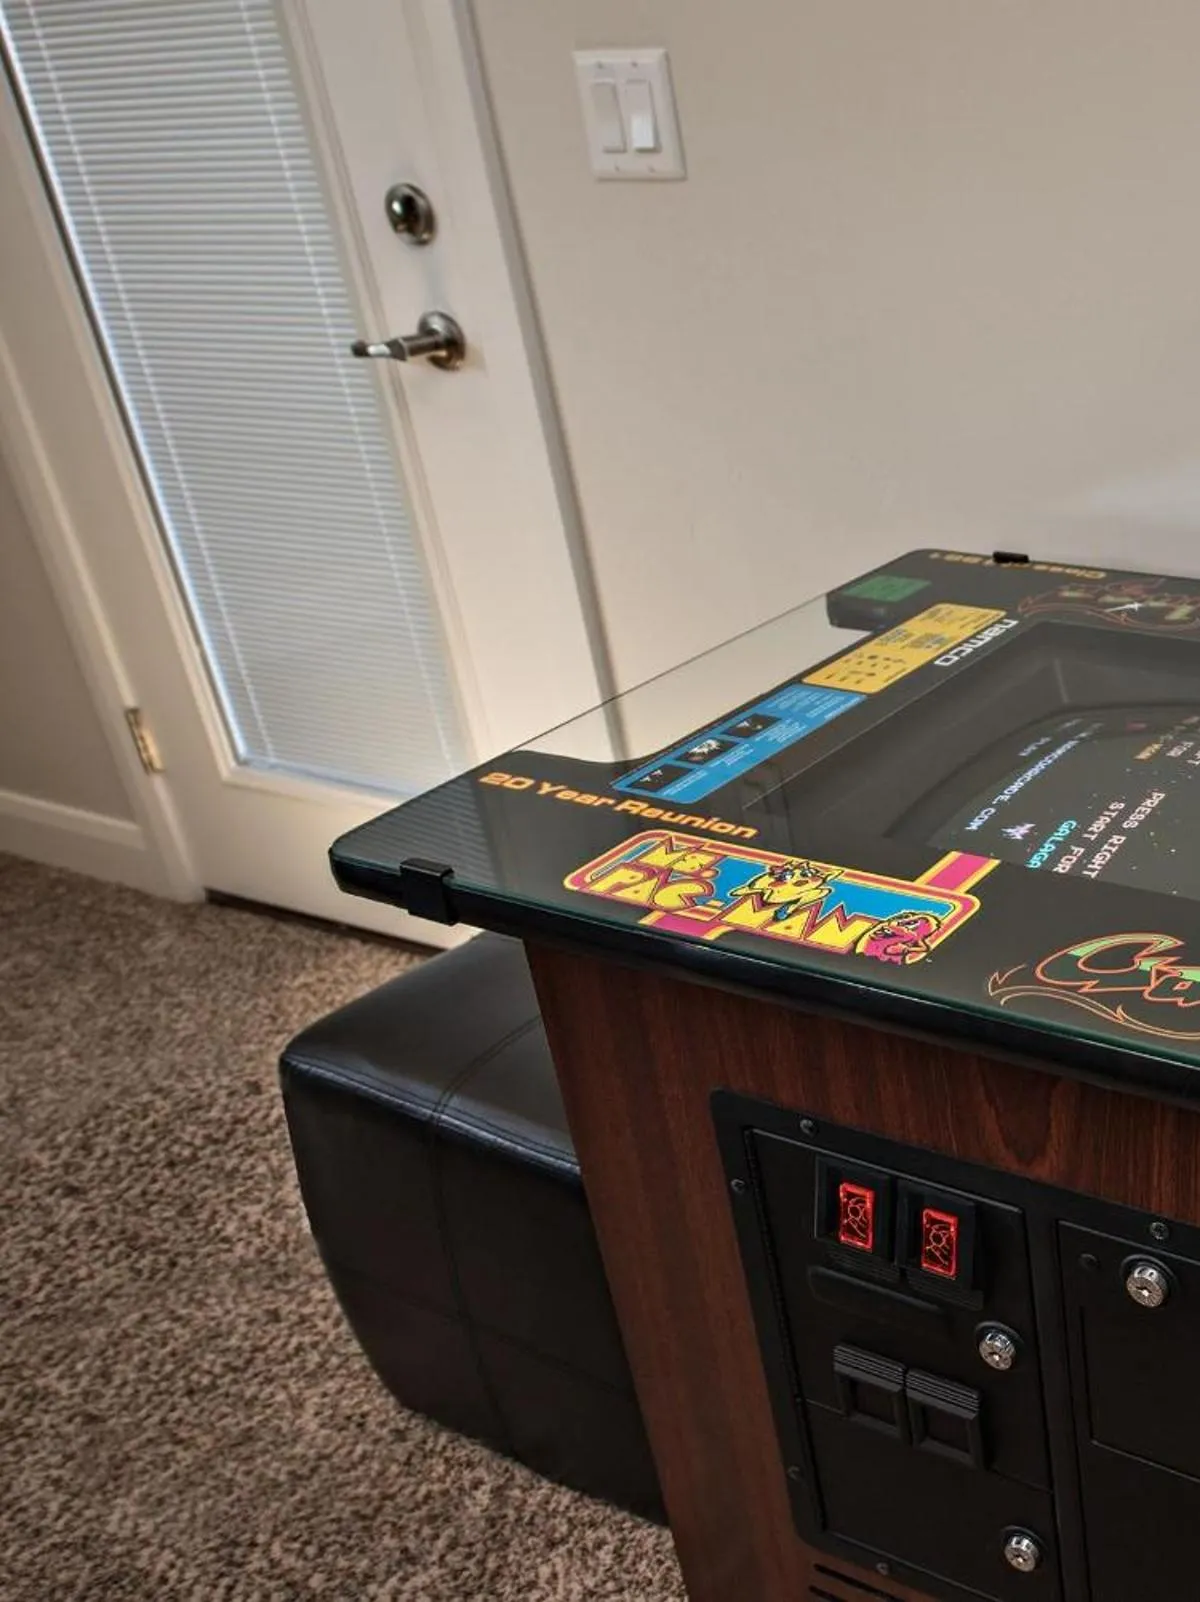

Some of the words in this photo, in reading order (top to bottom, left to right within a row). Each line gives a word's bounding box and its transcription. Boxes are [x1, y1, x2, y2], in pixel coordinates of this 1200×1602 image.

[477, 770, 535, 794] 20
[534, 780, 616, 814] Year
[613, 798, 760, 839] Reunion
[1082, 801, 1126, 842] START
[1122, 790, 1166, 830] PRESS
[1025, 819, 1078, 870] GALAGA
[1051, 844, 1085, 875] FOR
[1081, 833, 1127, 880] RIGHT
